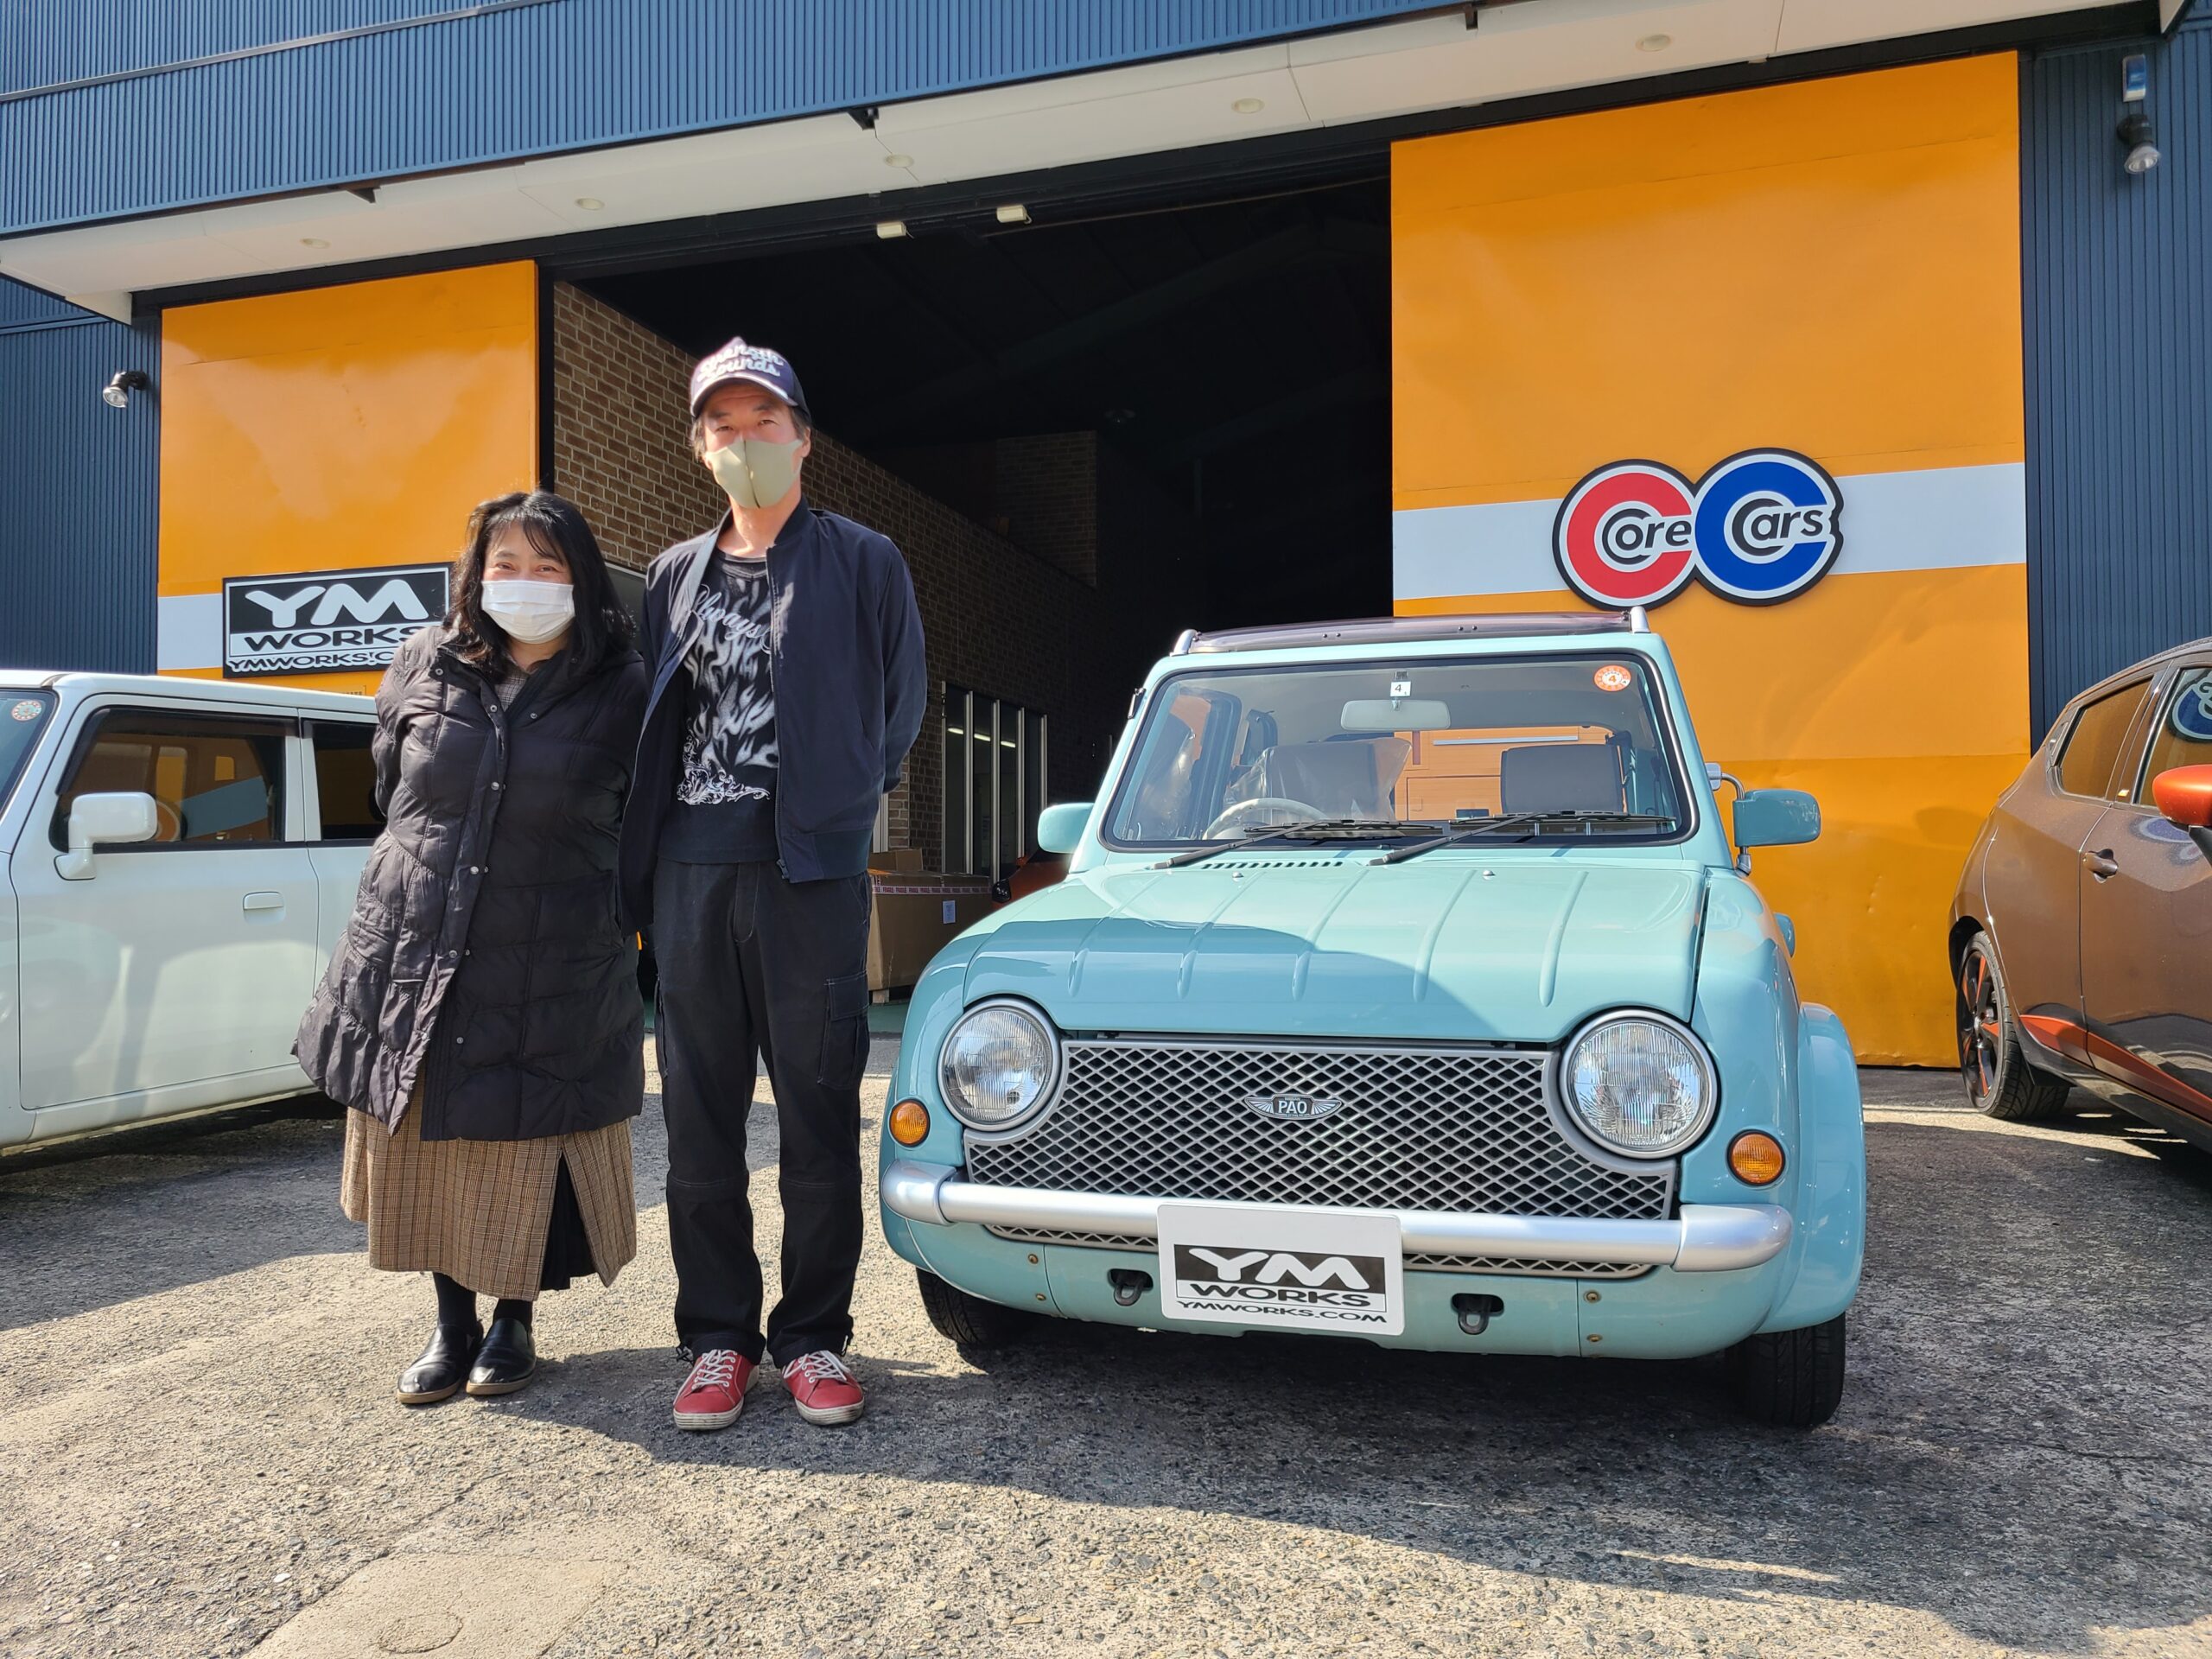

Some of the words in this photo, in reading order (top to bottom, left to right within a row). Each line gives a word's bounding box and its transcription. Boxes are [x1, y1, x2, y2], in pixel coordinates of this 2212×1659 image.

[245, 579, 429, 629] YM
[229, 651, 395, 671] YMWORKS.C
[1395, 683, 1402, 692] 4
[1278, 1100, 1307, 1115] PAO
[1188, 1248, 1370, 1291] YM
[1190, 1283, 1371, 1308] WORKS
[1177, 1300, 1388, 1324] YMWORKS.COM
